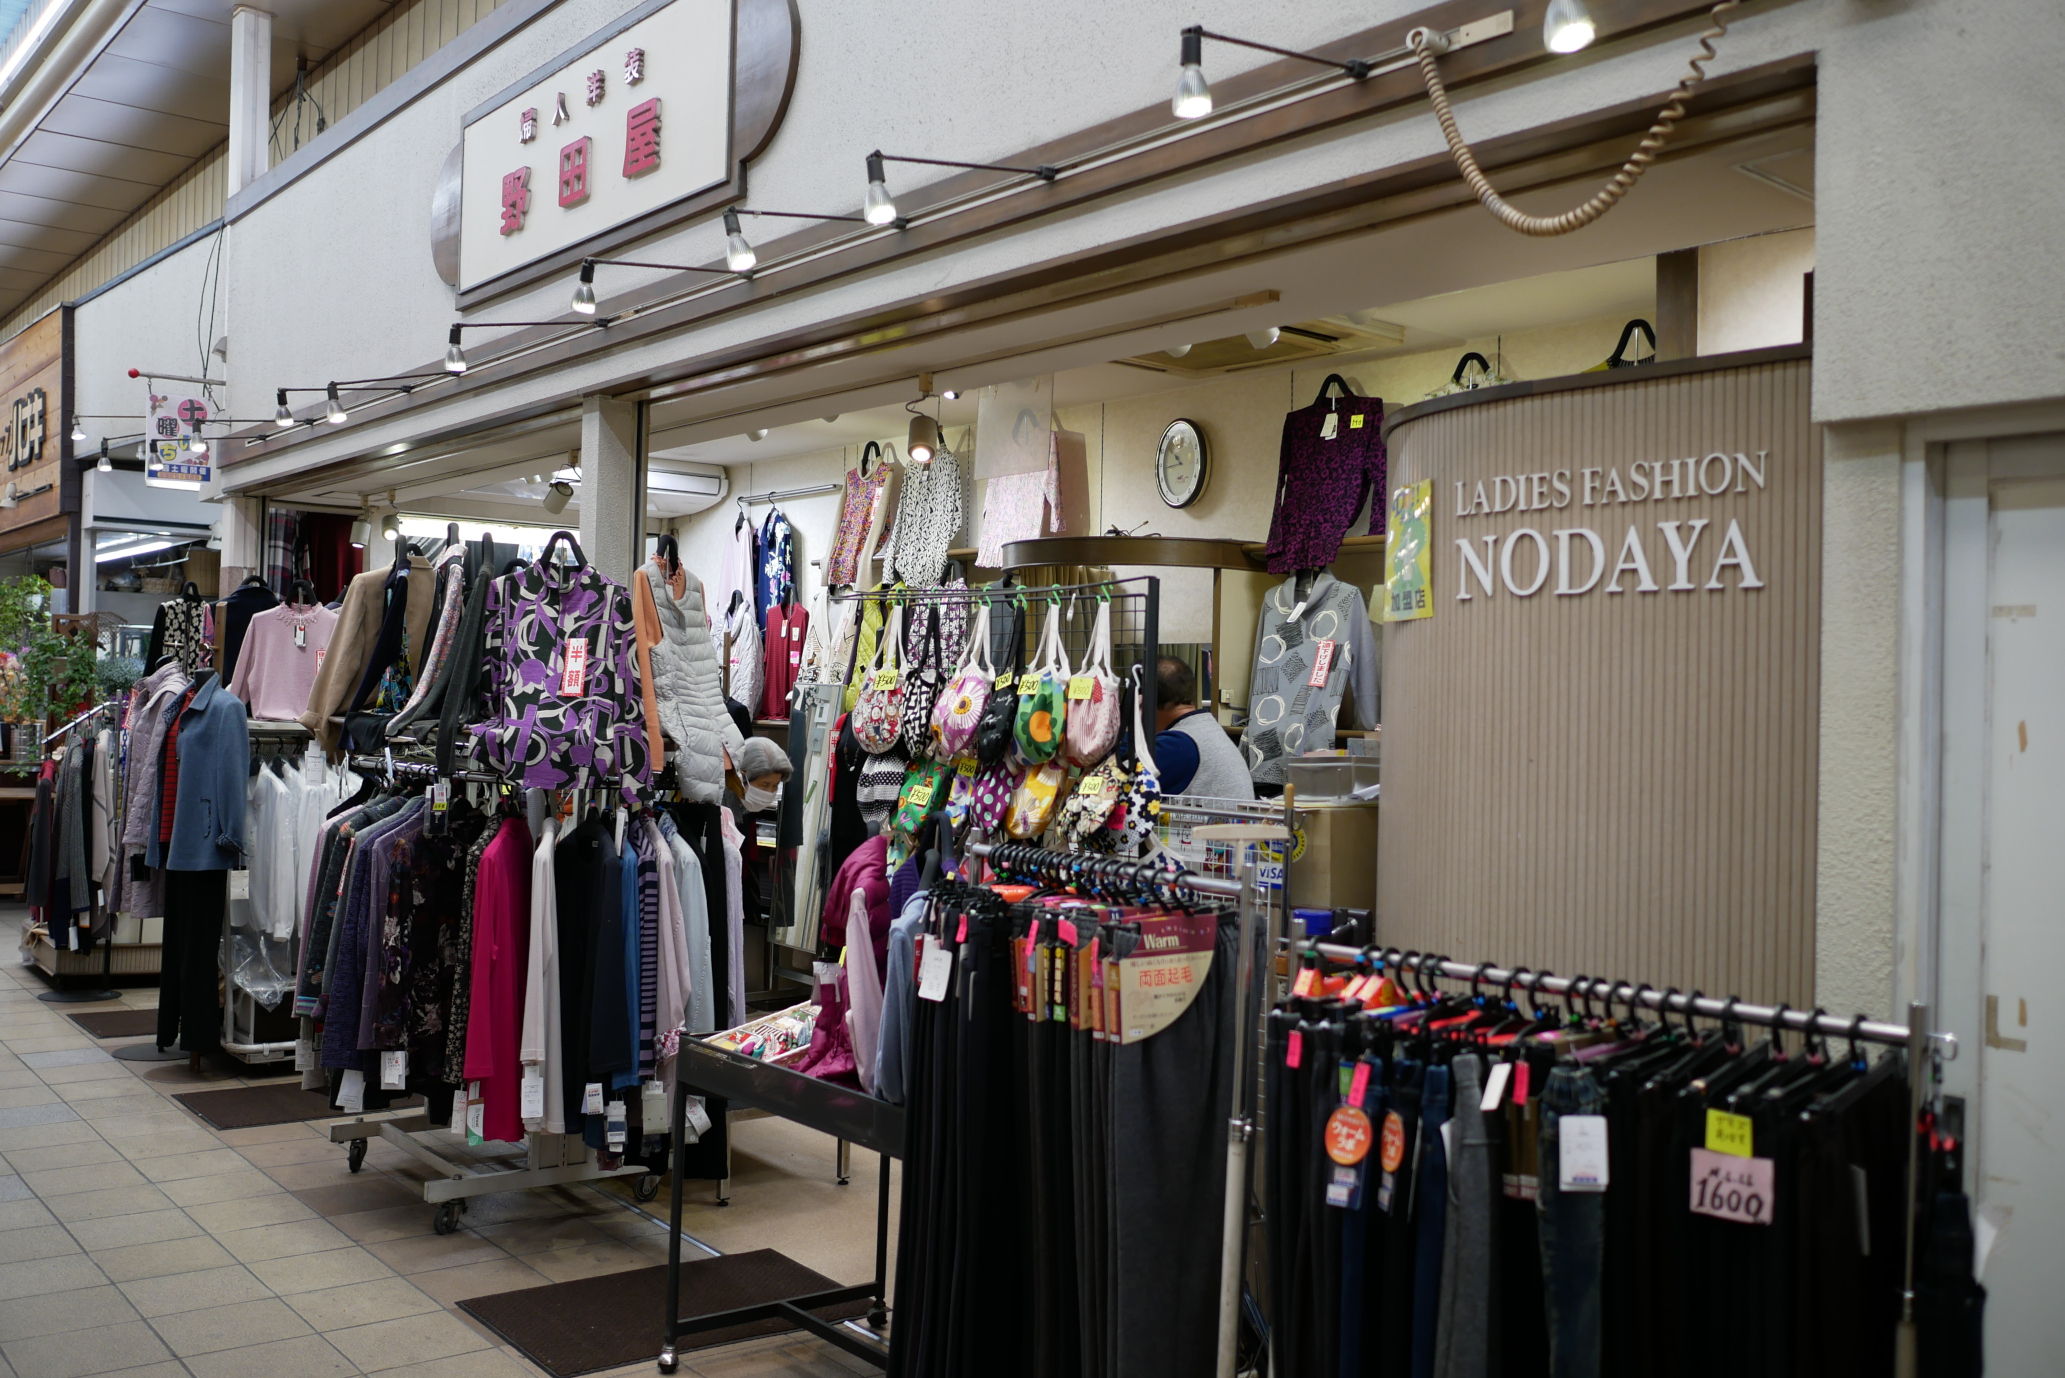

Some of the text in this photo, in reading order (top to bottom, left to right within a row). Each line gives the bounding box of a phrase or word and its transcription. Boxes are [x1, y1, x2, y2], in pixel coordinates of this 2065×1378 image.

[519, 47, 646, 144] 婦人洋装
[500, 96, 662, 236] 野田屋
[1454, 468, 1573, 517] LADIES
[1580, 450, 1770, 506] FASHION
[1454, 517, 1766, 600] NODAYA
[1391, 587, 1426, 613] 加盟店
[568, 645, 583, 688] 半額
[874, 673, 896, 689] ¥500
[1019, 678, 1039, 693] ¥500
[959, 761, 976, 776] ¥500
[908, 788, 931, 804] ¥500
[1259, 867, 1284, 881] VISA
[1143, 933, 1180, 951] Warm
[1138, 965, 1194, 988] 両面起毛
[1696, 1177, 1764, 1218] 1600
